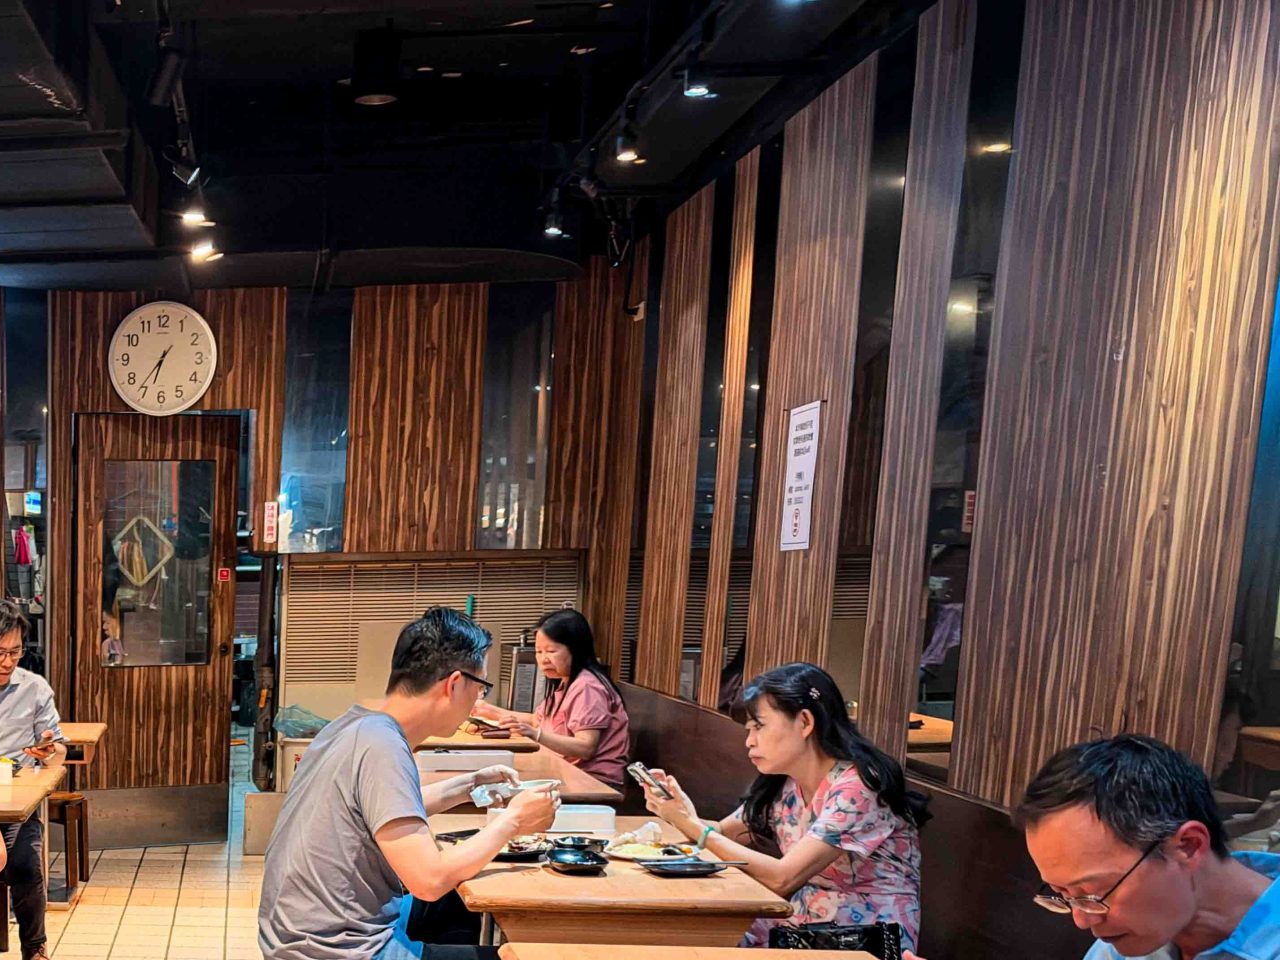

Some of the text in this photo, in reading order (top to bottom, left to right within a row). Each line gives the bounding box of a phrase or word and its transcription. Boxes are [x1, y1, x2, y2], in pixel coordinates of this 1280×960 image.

[141, 321, 151, 333] 11
[157, 315, 170, 328] 12
[179, 320, 184, 332] 1
[127, 334, 138, 347] 10
[191, 333, 199, 346] 2
[121, 353, 129, 366] 9
[195, 352, 203, 365] 3
[128, 372, 136, 385] 8
[189, 371, 197, 384] 4
[140, 386, 148, 399] 7
[157, 391, 165, 403] 6
[176, 385, 183, 398] 5
